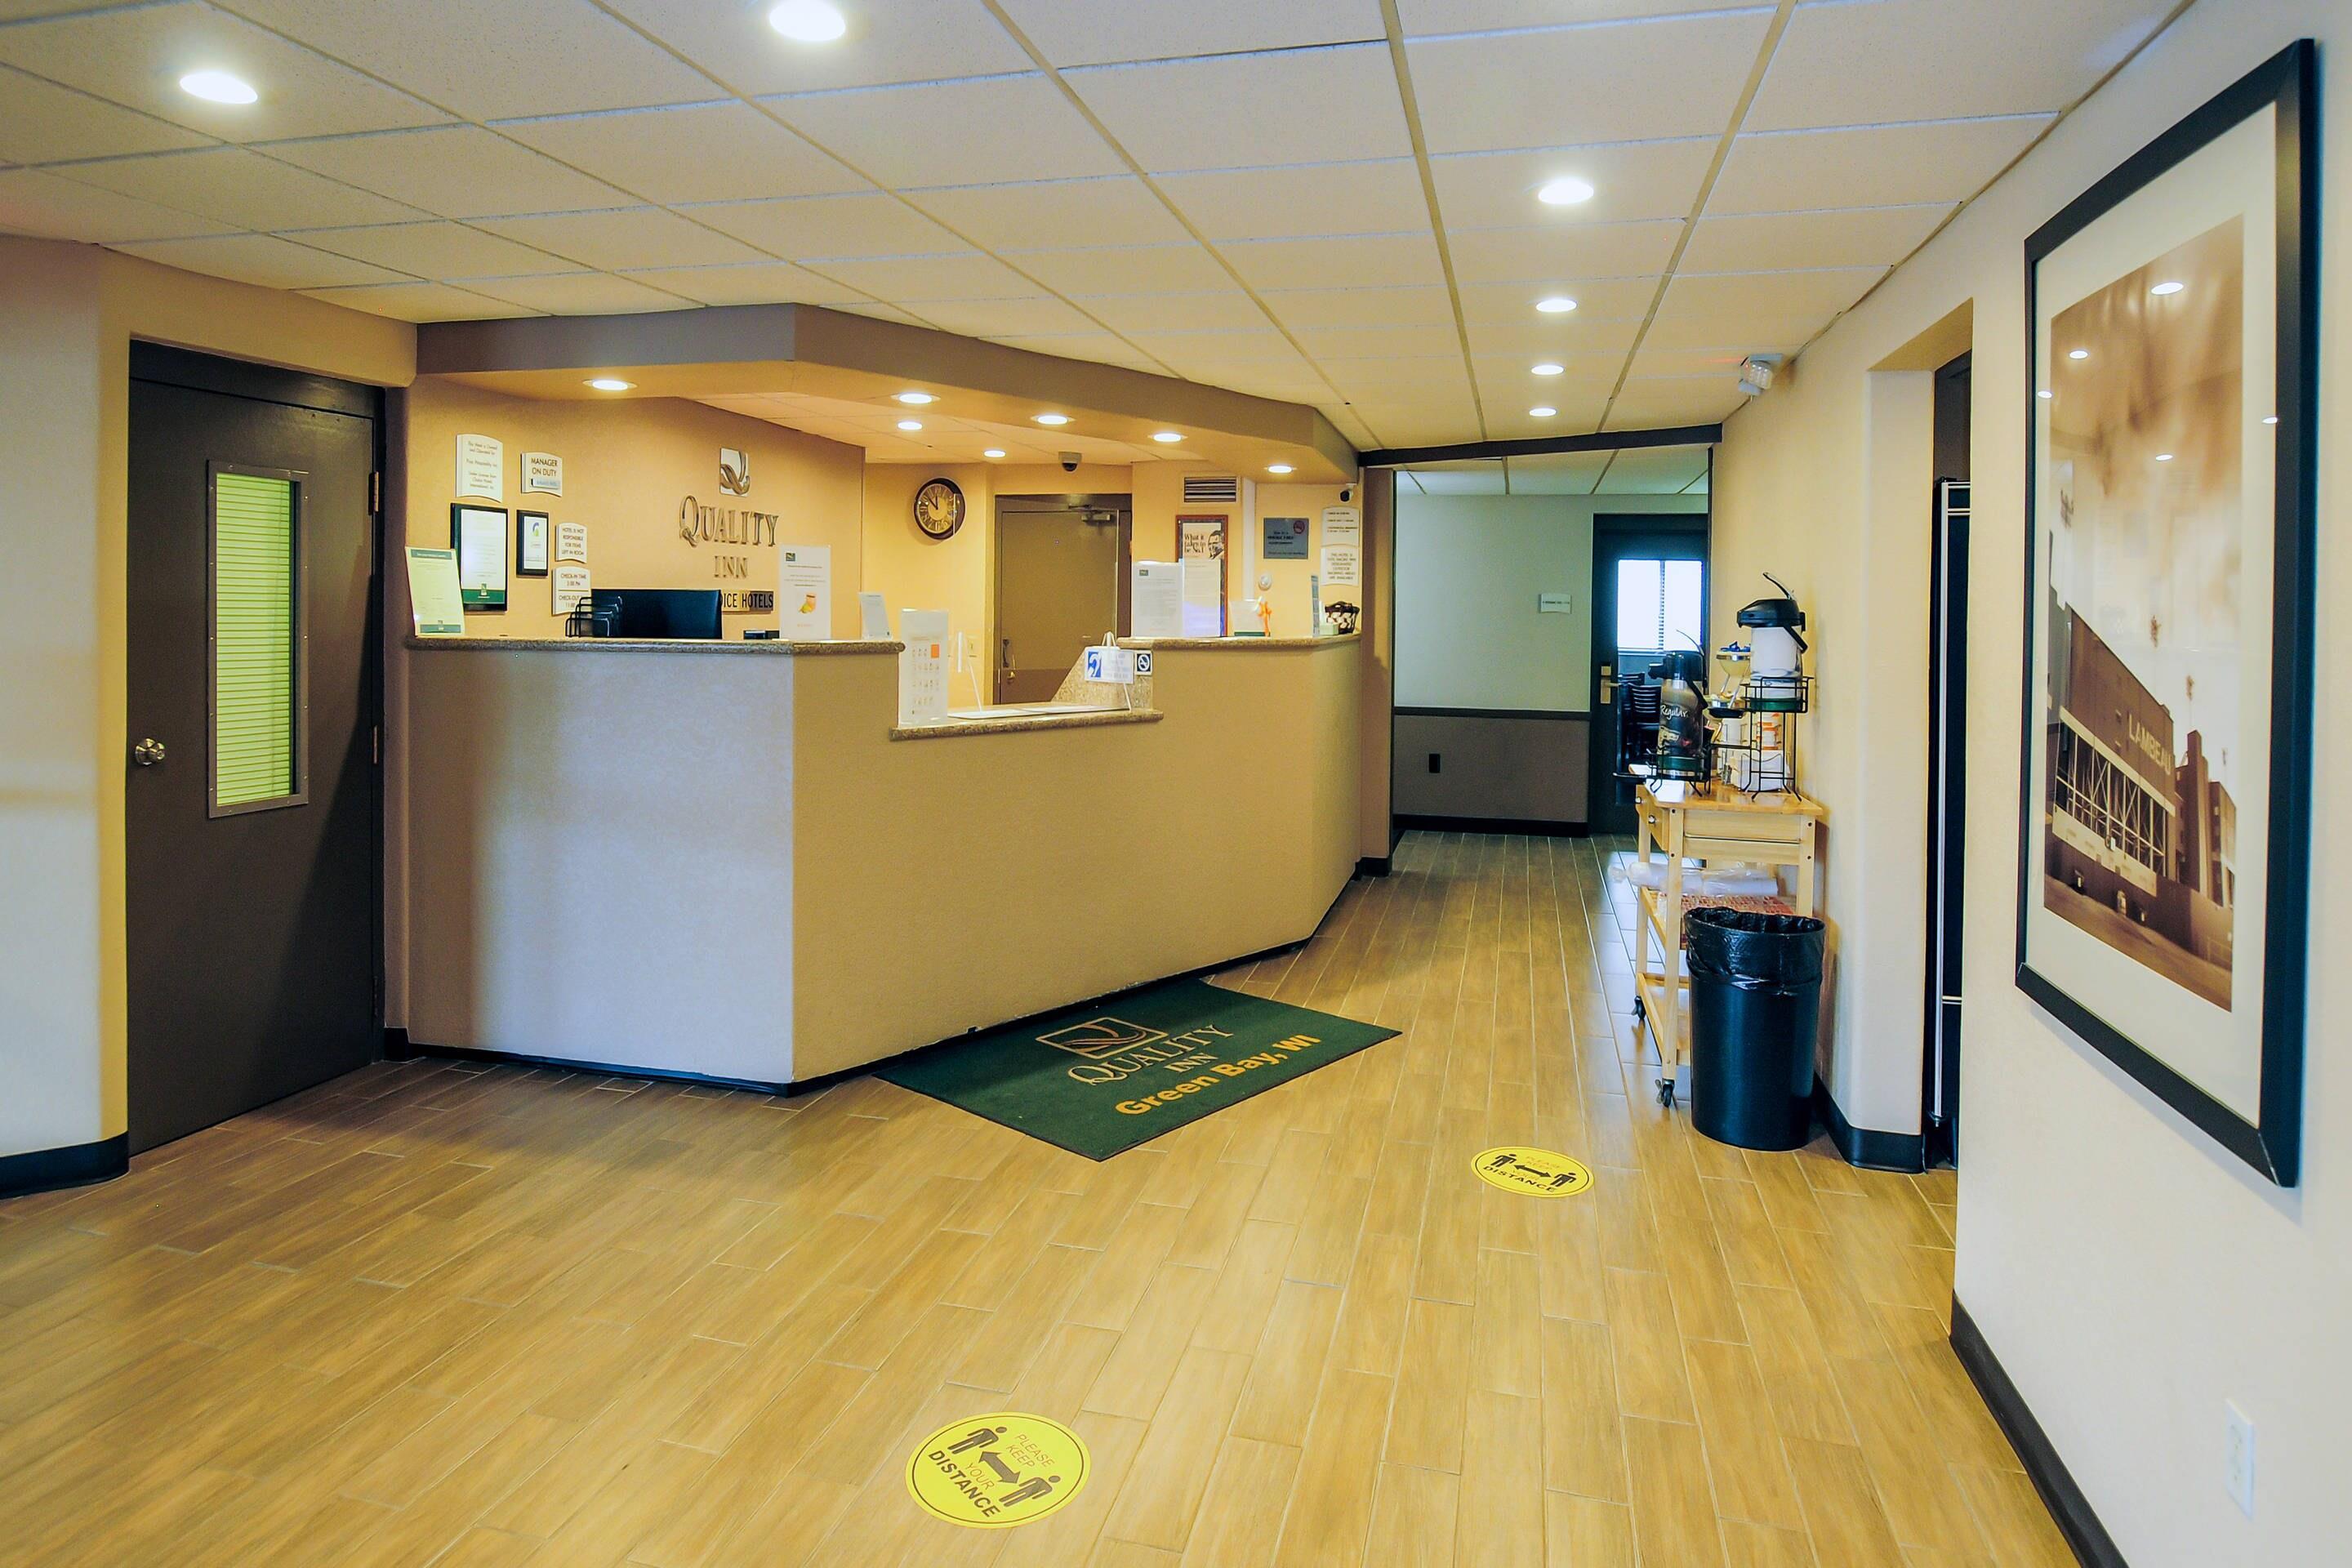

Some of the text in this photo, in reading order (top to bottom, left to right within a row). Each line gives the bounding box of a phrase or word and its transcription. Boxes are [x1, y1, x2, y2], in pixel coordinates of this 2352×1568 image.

[531, 457, 558, 467] MANAGER
[532, 467, 557, 477] ON DUTY
[679, 495, 779, 547] QUALITY
[714, 555, 748, 578] INN
[742, 593, 773, 608] HOTELS
[1660, 704, 1688, 720] Regular
[2128, 713, 2172, 776] LAMBEAU
[1068, 1024, 1234, 1086] QUALITY
[1164, 1052, 1219, 1073] INN
[1115, 1033, 1322, 1115] Green Bay, WI
[1483, 1165, 1557, 1192] DISTANCE
[1006, 1444, 1036, 1468] KEEP
[1015, 1433, 1055, 1468] PLEASE
[928, 1450, 1001, 1517] DISTANCE
[965, 1463, 995, 1490] YOUR
